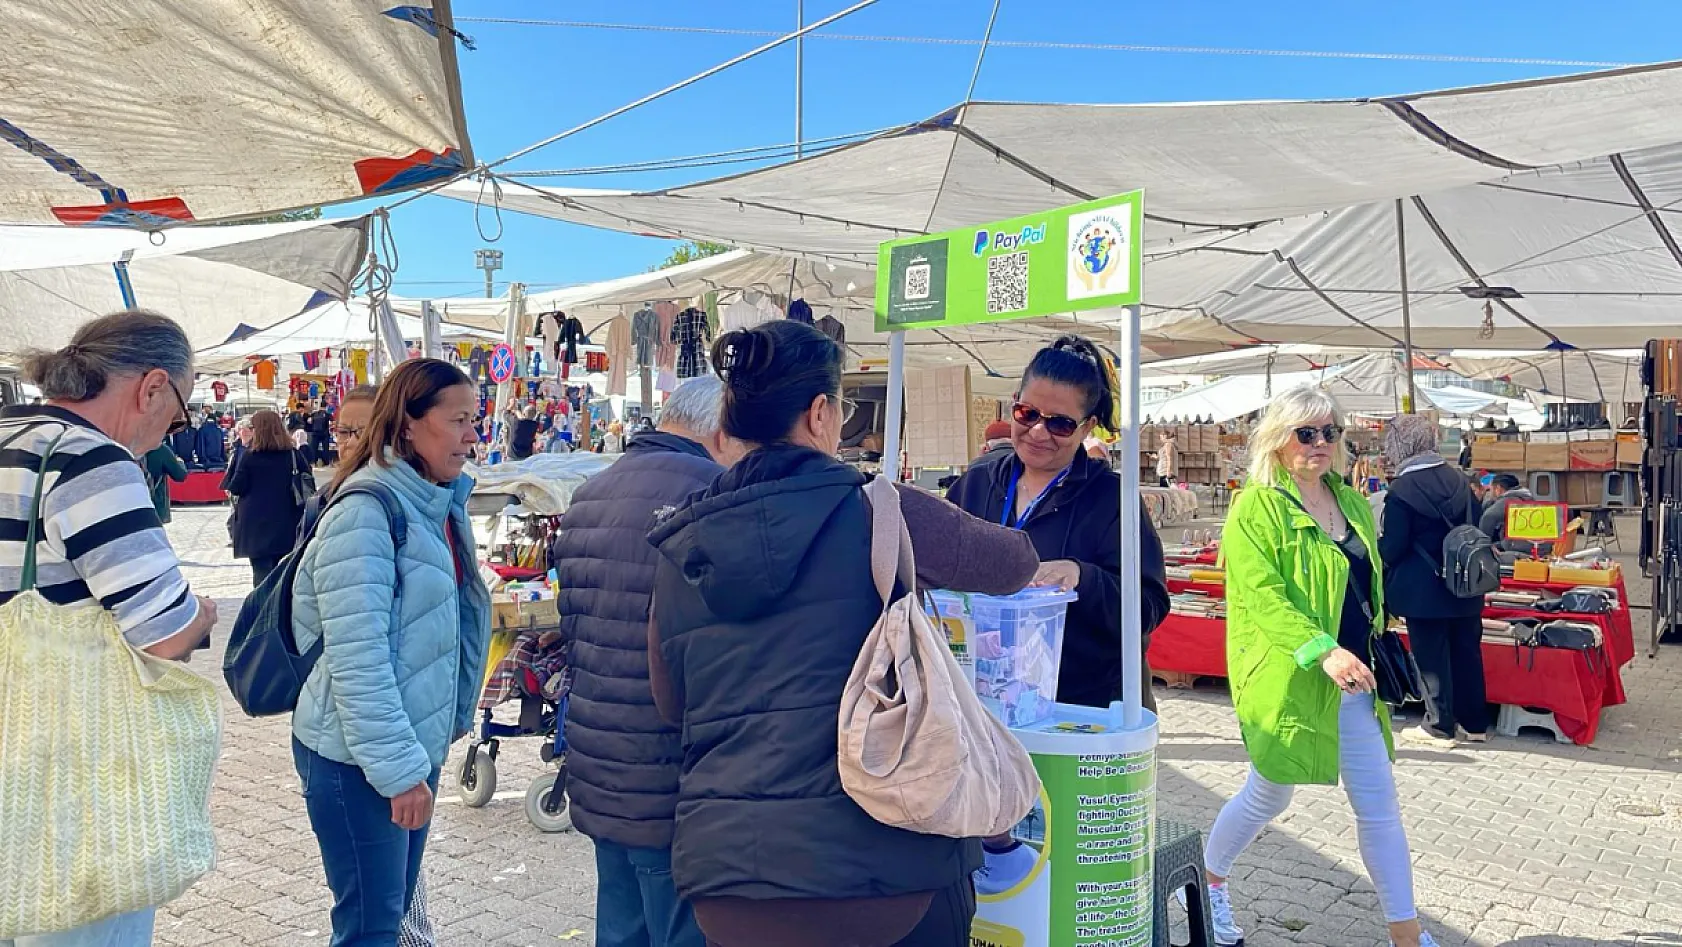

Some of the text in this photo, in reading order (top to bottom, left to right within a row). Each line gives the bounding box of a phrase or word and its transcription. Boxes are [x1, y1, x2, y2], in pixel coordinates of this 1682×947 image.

[994, 224, 1045, 249] PayPal
[1079, 766, 1102, 778] Help
[1105, 766, 1118, 776] Be
[1119, 767, 1125, 775] a
[1079, 795, 1107, 805] Yusuf
[1078, 810, 1116, 822] fighting
[1078, 824, 1122, 834] Muscular
[1086, 841, 1092, 849] a
[1094, 840, 1114, 848] rare
[1117, 837, 1132, 846] and
[1078, 851, 1132, 864] threatening
[1077, 883, 1100, 893] With
[1102, 882, 1122, 894] your
[1077, 897, 1098, 910] give
[1101, 896, 1117, 907] him
[1119, 896, 1125, 904] a
[1077, 912, 1088, 922] at
[1090, 911, 1106, 922] life
[1115, 909, 1128, 919] the
[1077, 928, 1097, 937] The
